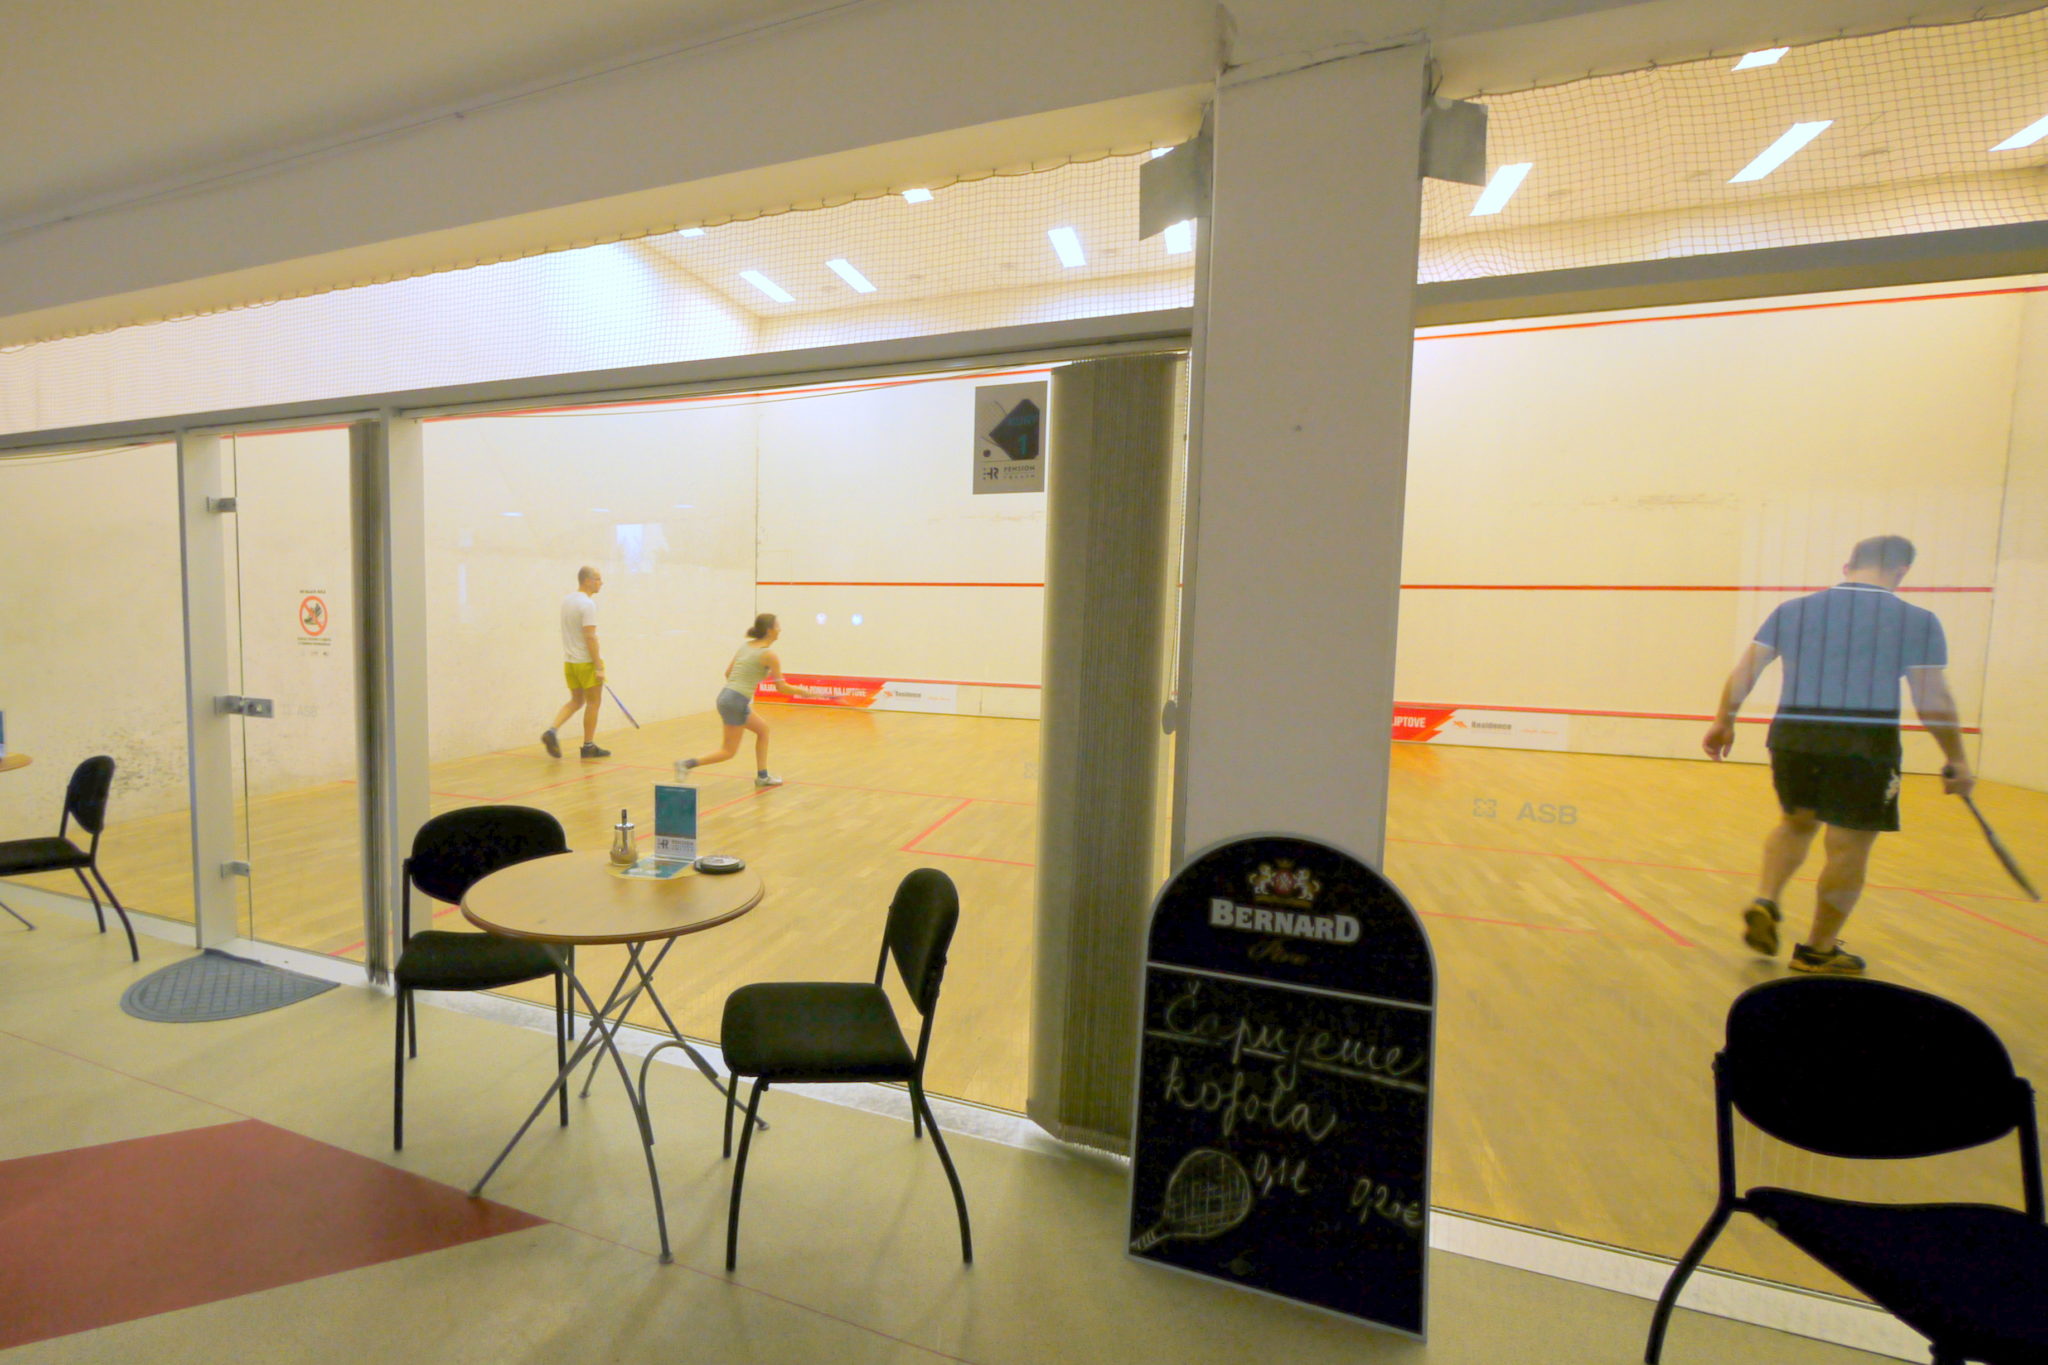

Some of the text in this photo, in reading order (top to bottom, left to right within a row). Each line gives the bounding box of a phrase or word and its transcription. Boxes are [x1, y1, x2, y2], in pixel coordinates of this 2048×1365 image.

[1018, 433, 1028, 456] 1
[1471, 720, 1512, 730] Residence
[1517, 801, 1578, 825] ASB
[1210, 898, 1361, 944] BERNARD
